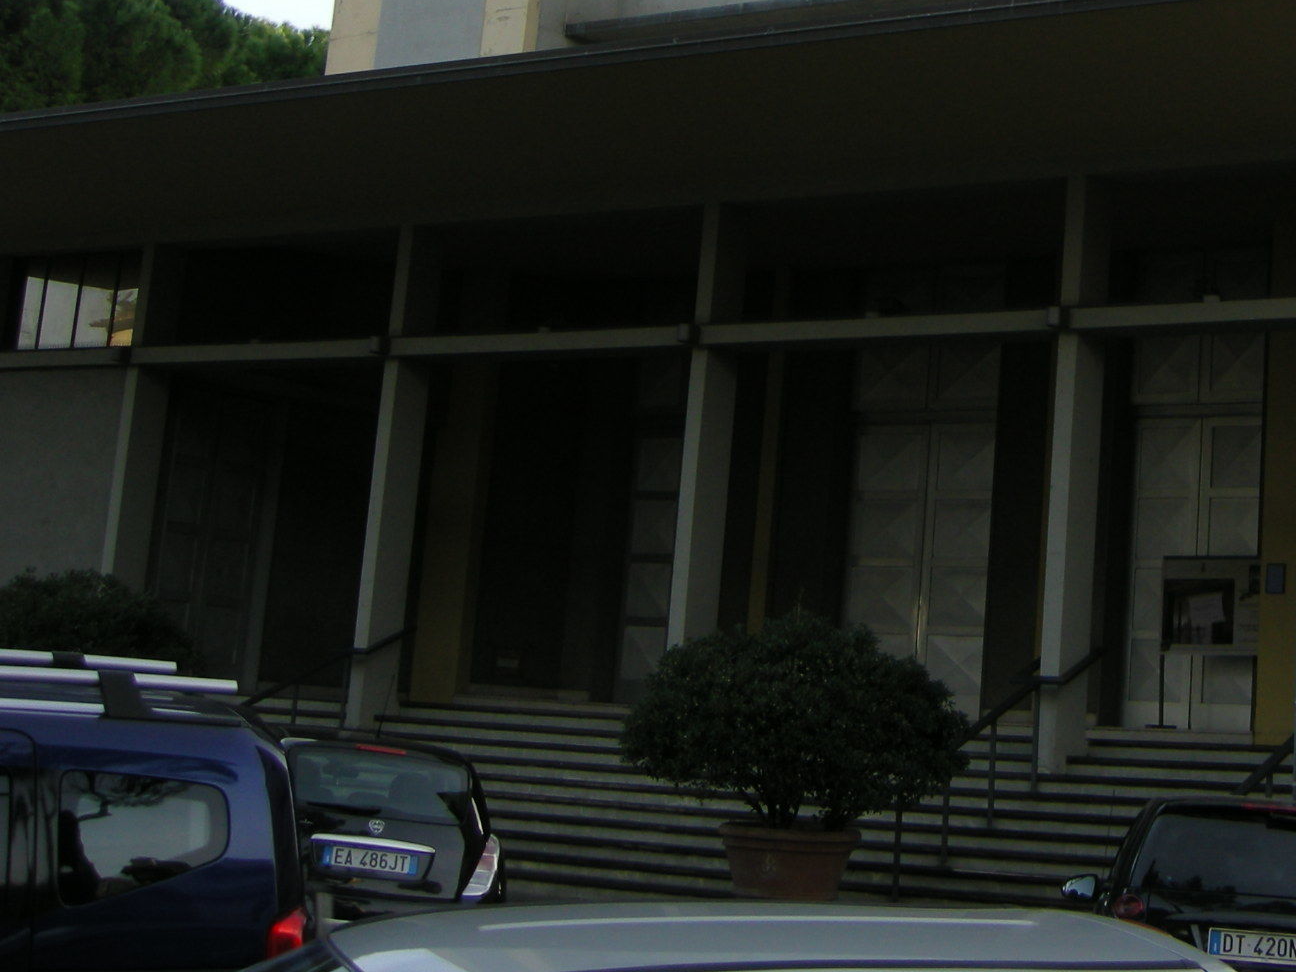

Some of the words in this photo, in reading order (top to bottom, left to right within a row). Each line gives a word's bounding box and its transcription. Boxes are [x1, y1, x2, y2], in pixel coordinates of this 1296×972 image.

[334, 848, 353, 865] EA
[359, 851, 408, 872] 486JT
[1223, 933, 1246, 954] DT
